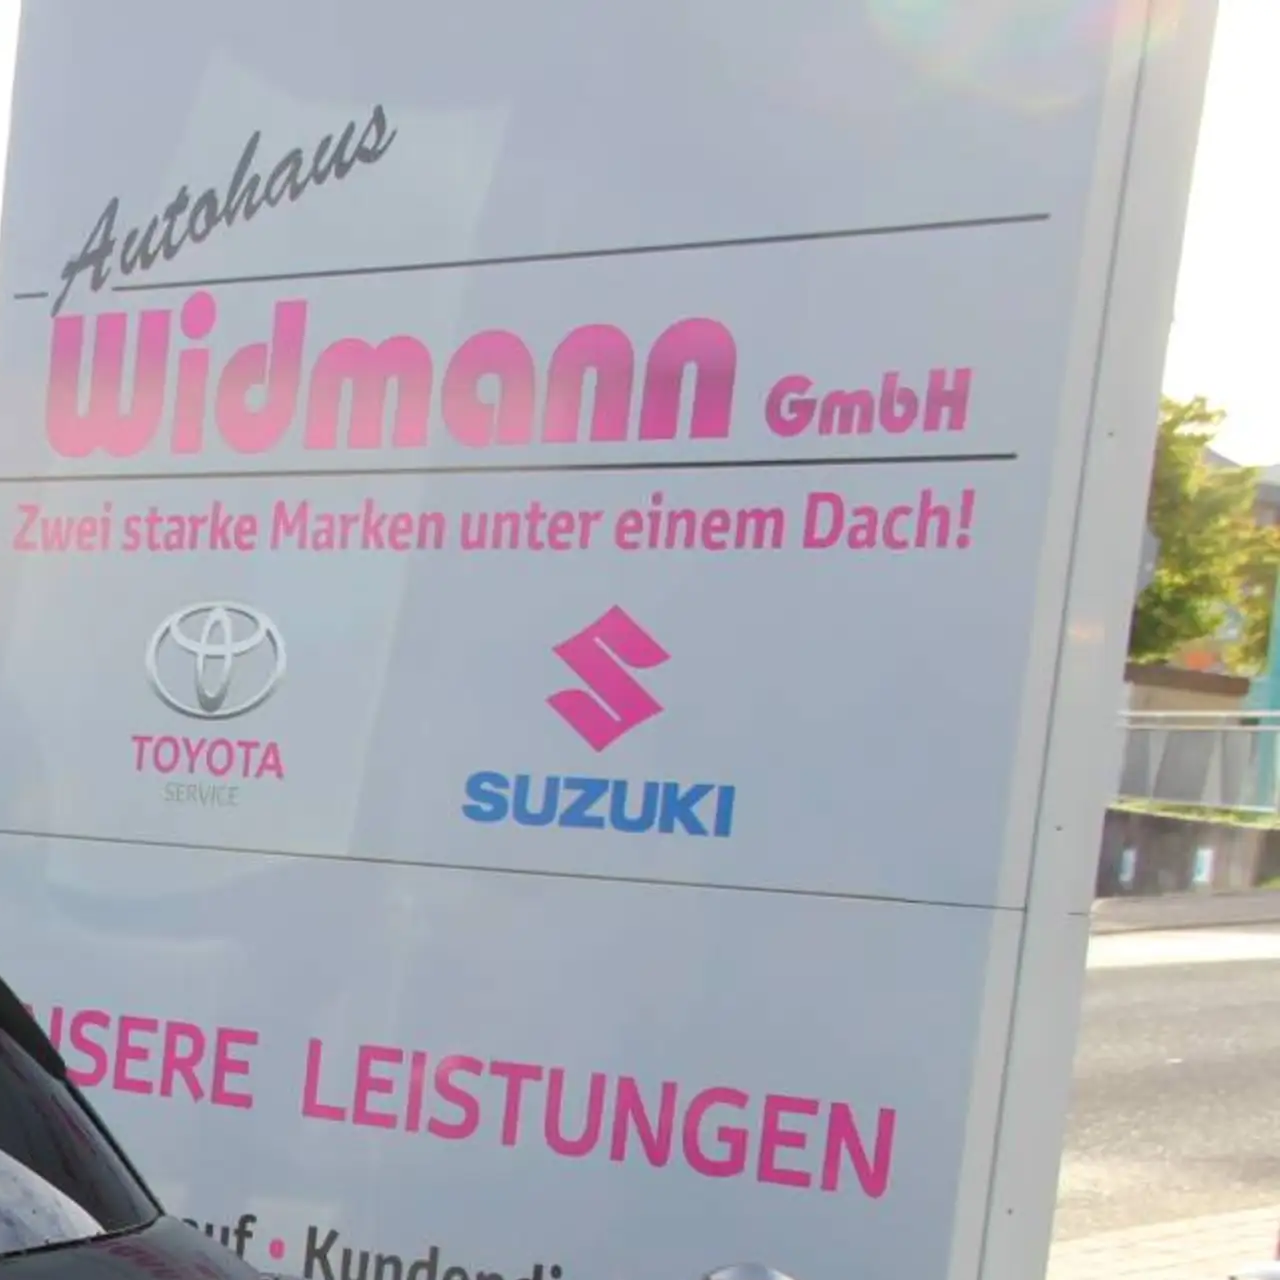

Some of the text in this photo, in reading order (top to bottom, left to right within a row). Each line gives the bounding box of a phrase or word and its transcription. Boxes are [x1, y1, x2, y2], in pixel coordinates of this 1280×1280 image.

[50, 103, 398, 318] Autohaus
[48, 290, 975, 457] Widmann GmbH
[13, 488, 976, 552] Zwei starke Marken unter einem Dach!
[131, 735, 285, 779] TOYOTA
[163, 781, 240, 807] SERVICE
[462, 771, 737, 838] SUZUKI
[21, 1003, 898, 1199] SERE LEISTUNGEN
